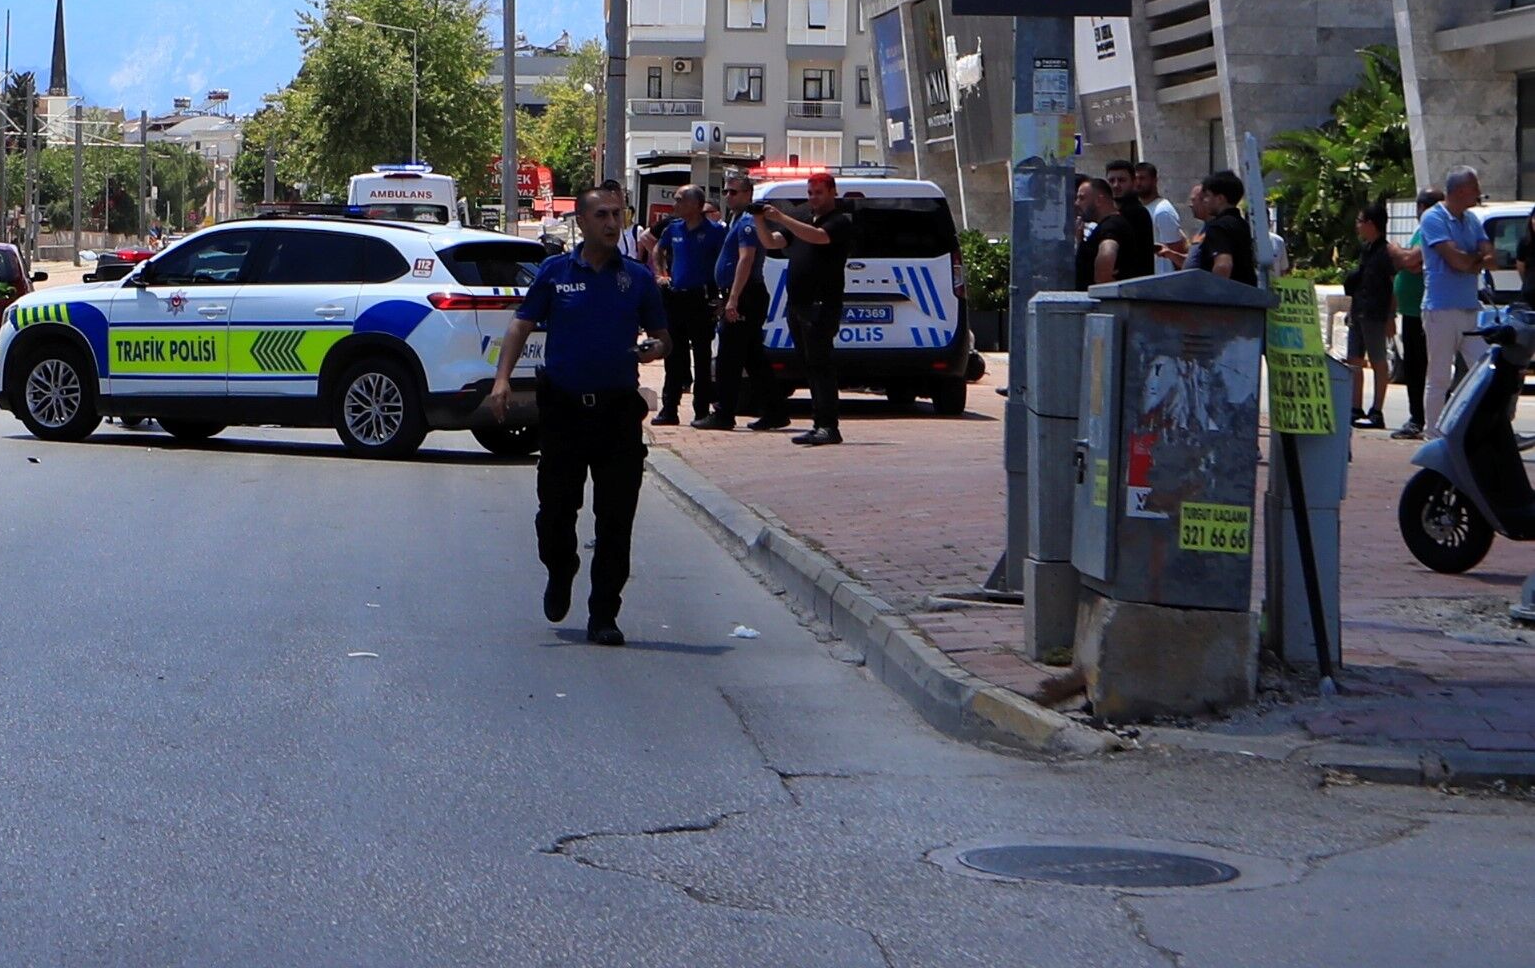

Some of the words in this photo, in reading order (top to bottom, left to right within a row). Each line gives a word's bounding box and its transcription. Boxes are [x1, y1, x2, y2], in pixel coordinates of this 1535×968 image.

[370, 190, 433, 199] AMBULANS
[417, 260, 432, 270] 112
[556, 283, 586, 293] POLIS
[858, 309, 886, 318] 7369
[116, 336, 166, 362] TRAFİK
[169, 336, 216, 362] POLİSİ
[1182, 525, 1205, 546] 321
[1210, 526, 1226, 548] 66
[1230, 526, 1247, 549] 66
